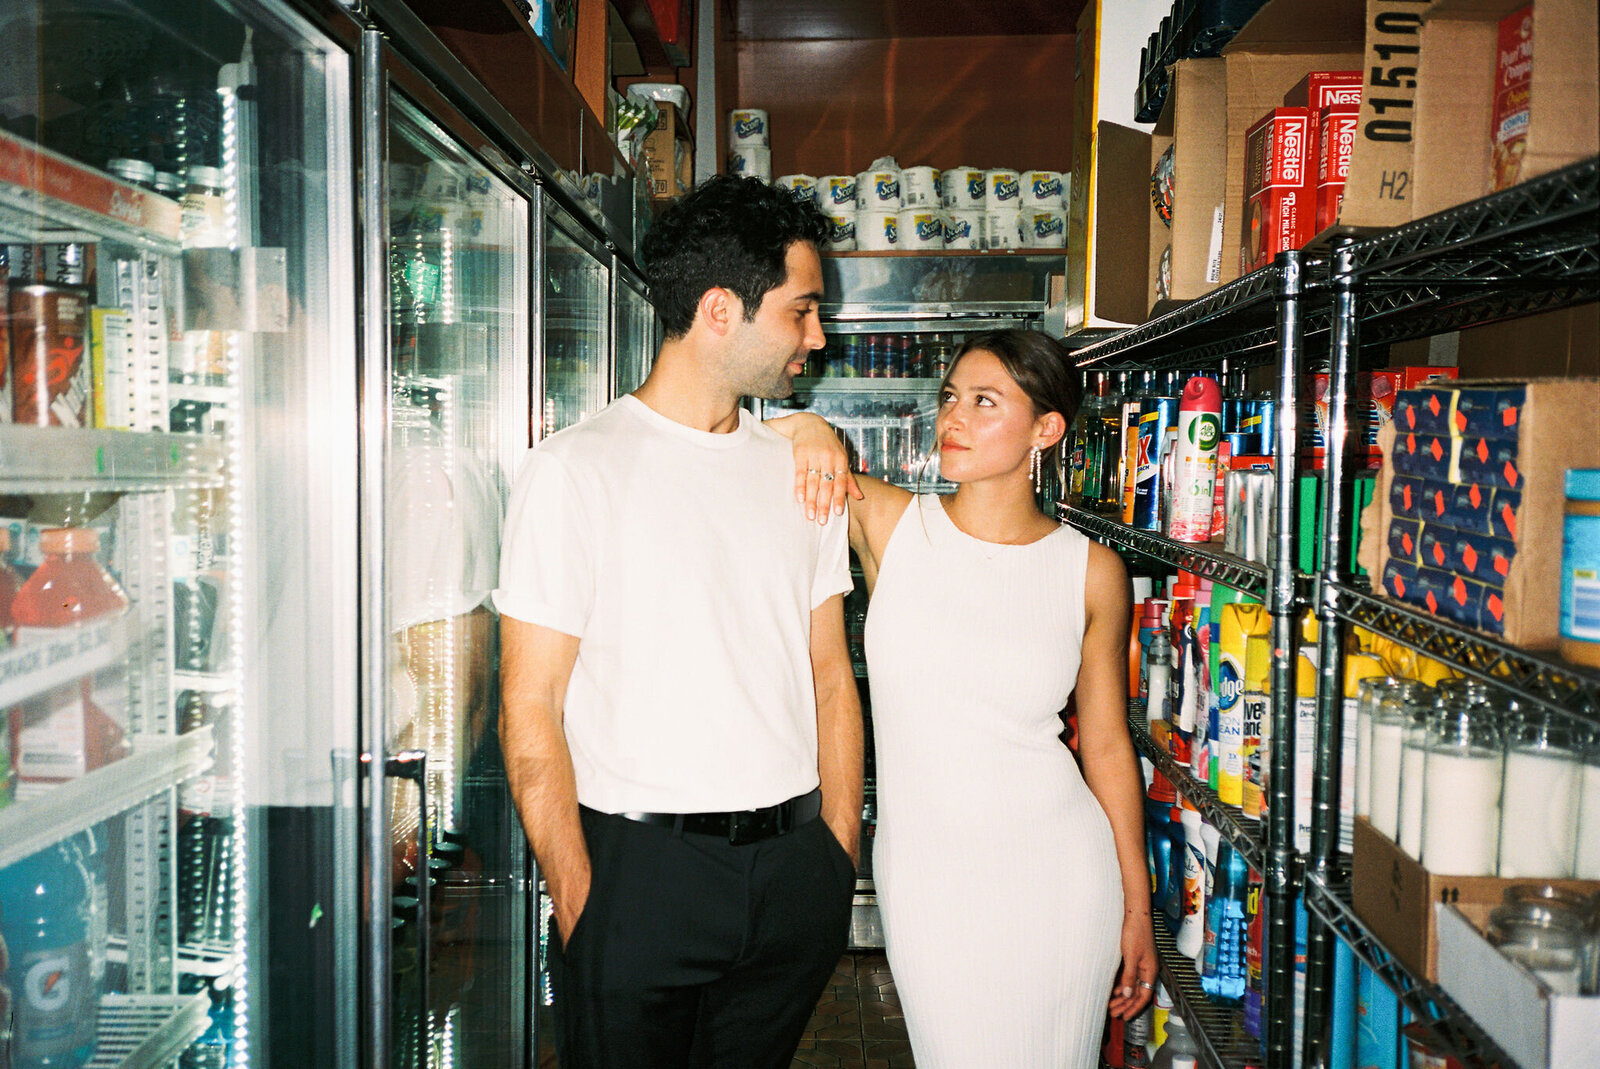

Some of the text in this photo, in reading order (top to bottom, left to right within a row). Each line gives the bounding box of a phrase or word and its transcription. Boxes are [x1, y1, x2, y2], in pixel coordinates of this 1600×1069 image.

[1364, 0, 1431, 142] 01510
[1503, 110, 1531, 132] COMPLE
[1379, 170, 1408, 200] H2
[1282, 220, 1290, 235] MILK
